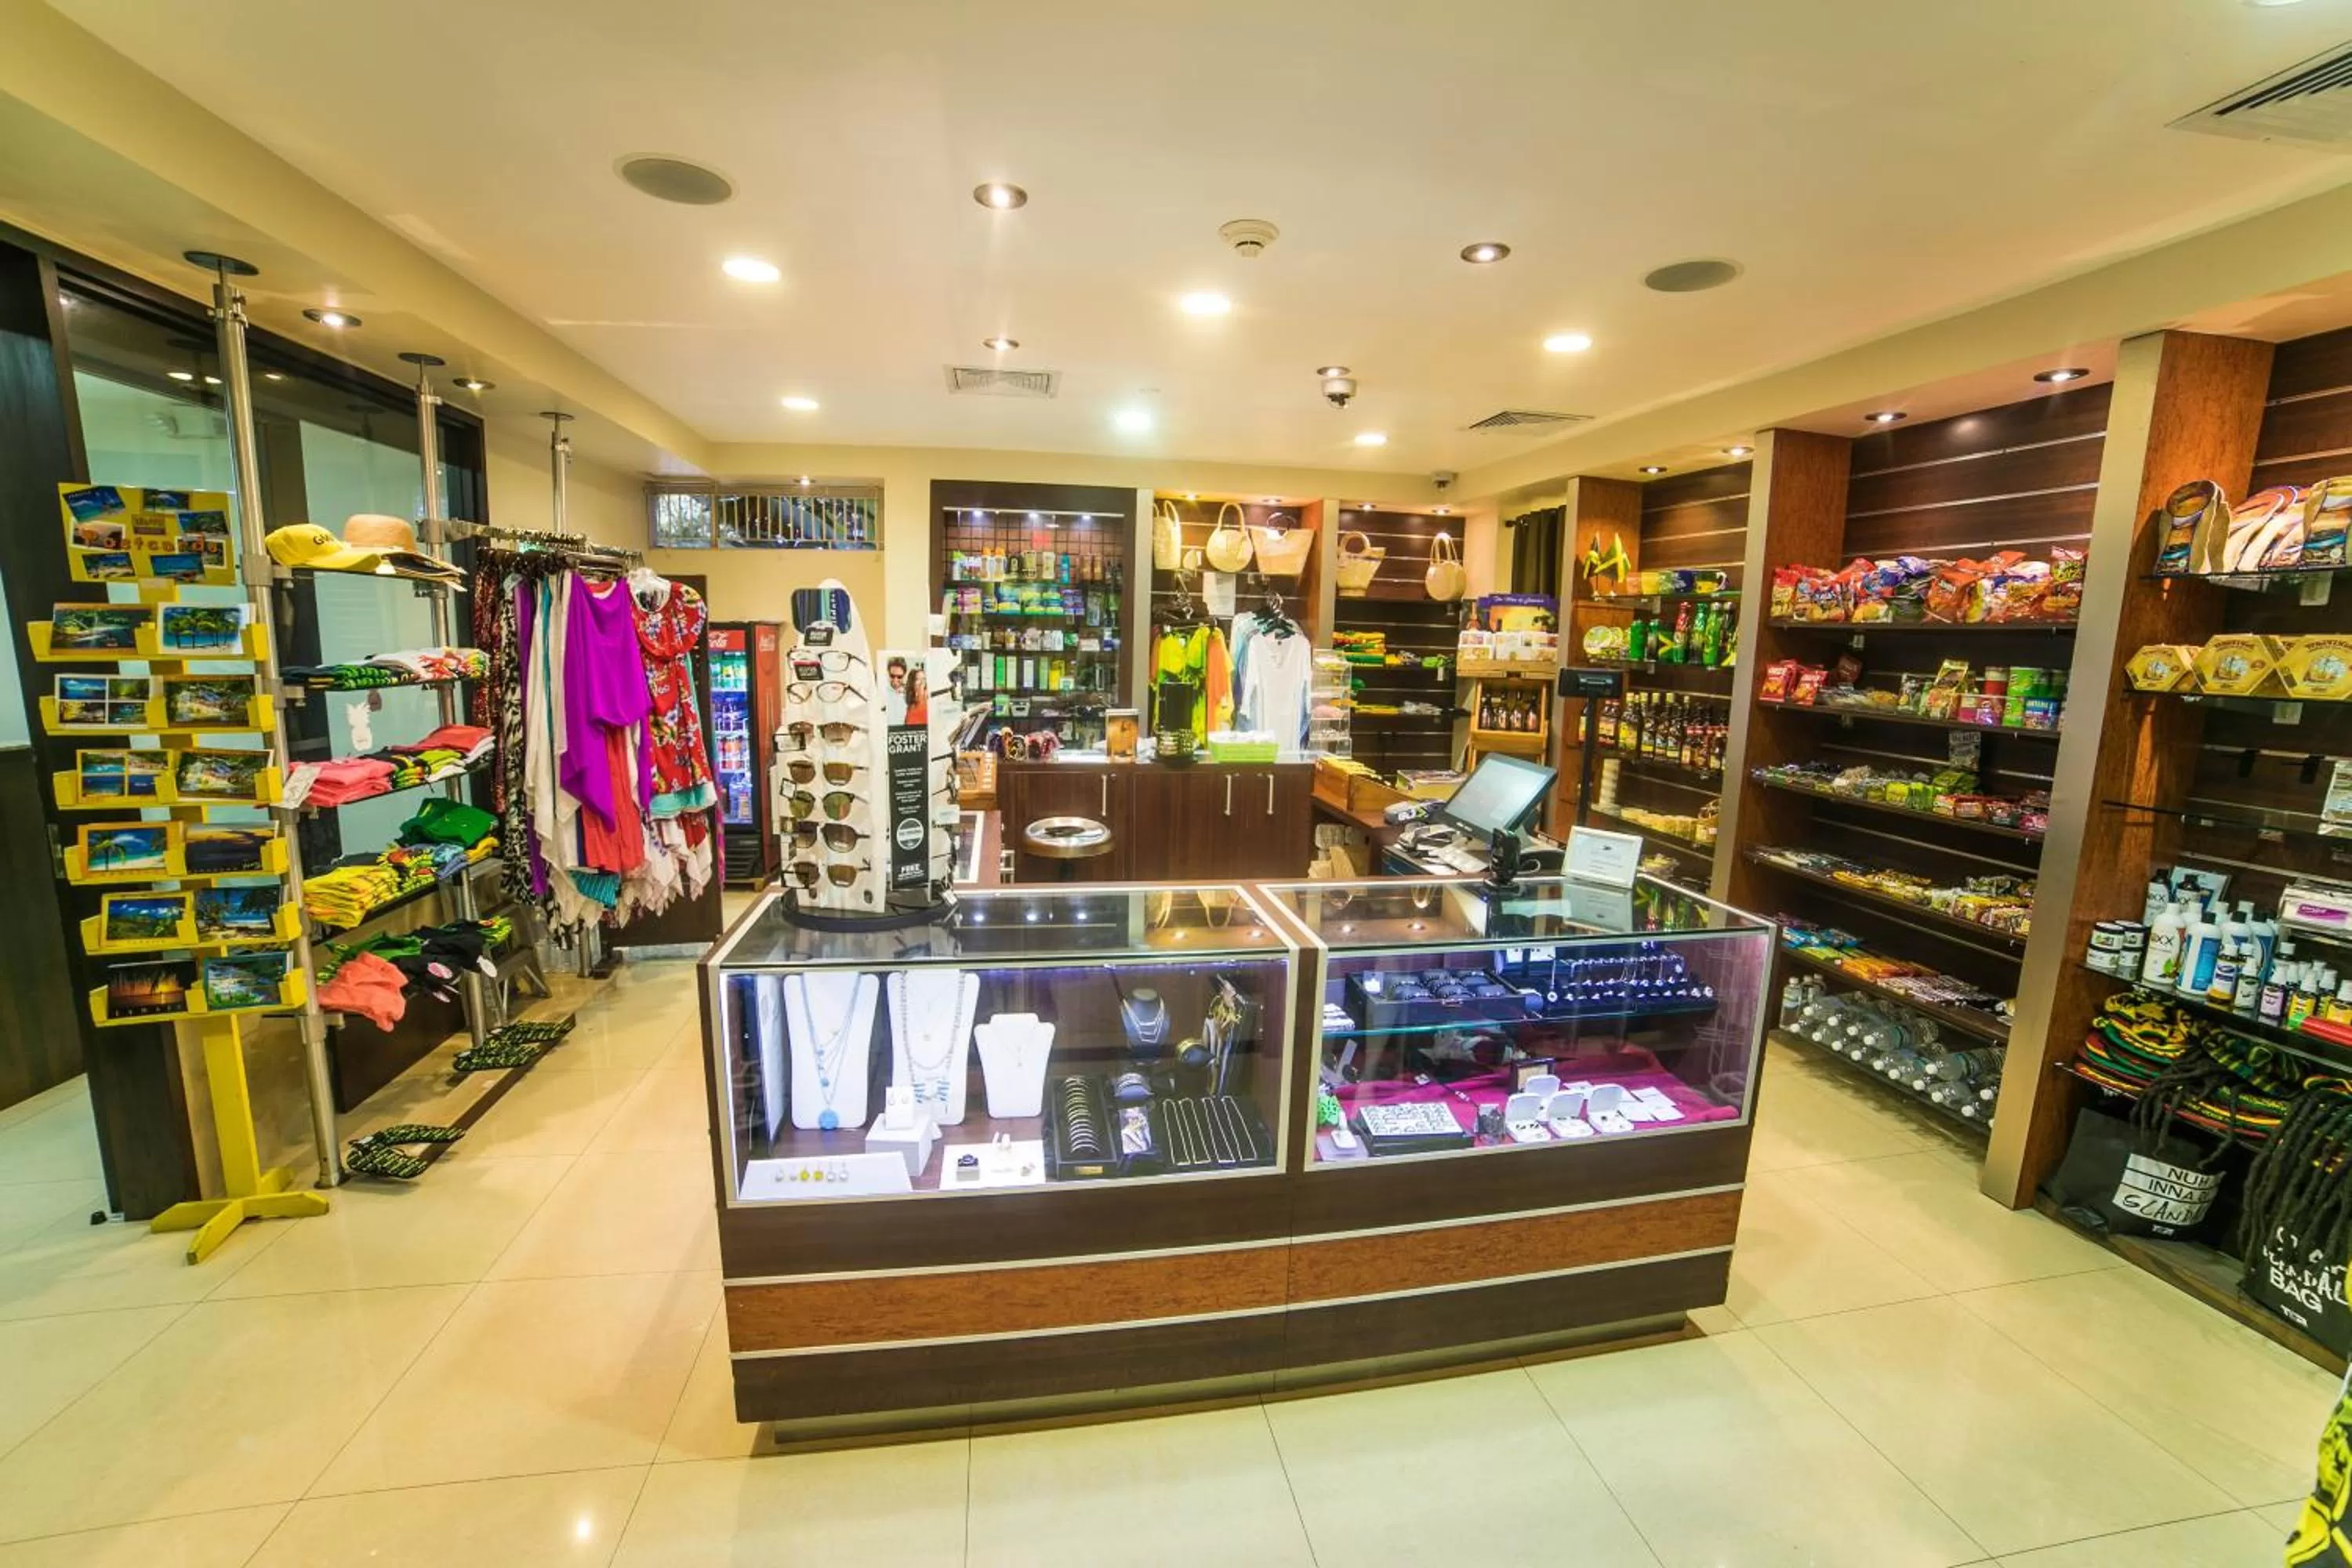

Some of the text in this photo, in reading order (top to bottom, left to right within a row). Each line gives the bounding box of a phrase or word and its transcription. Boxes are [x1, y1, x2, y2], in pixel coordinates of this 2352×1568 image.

[888, 734, 927, 745] FOSTER
[888, 743, 922, 754] GRANT
[2269, 1266, 2323, 1315] BAG
